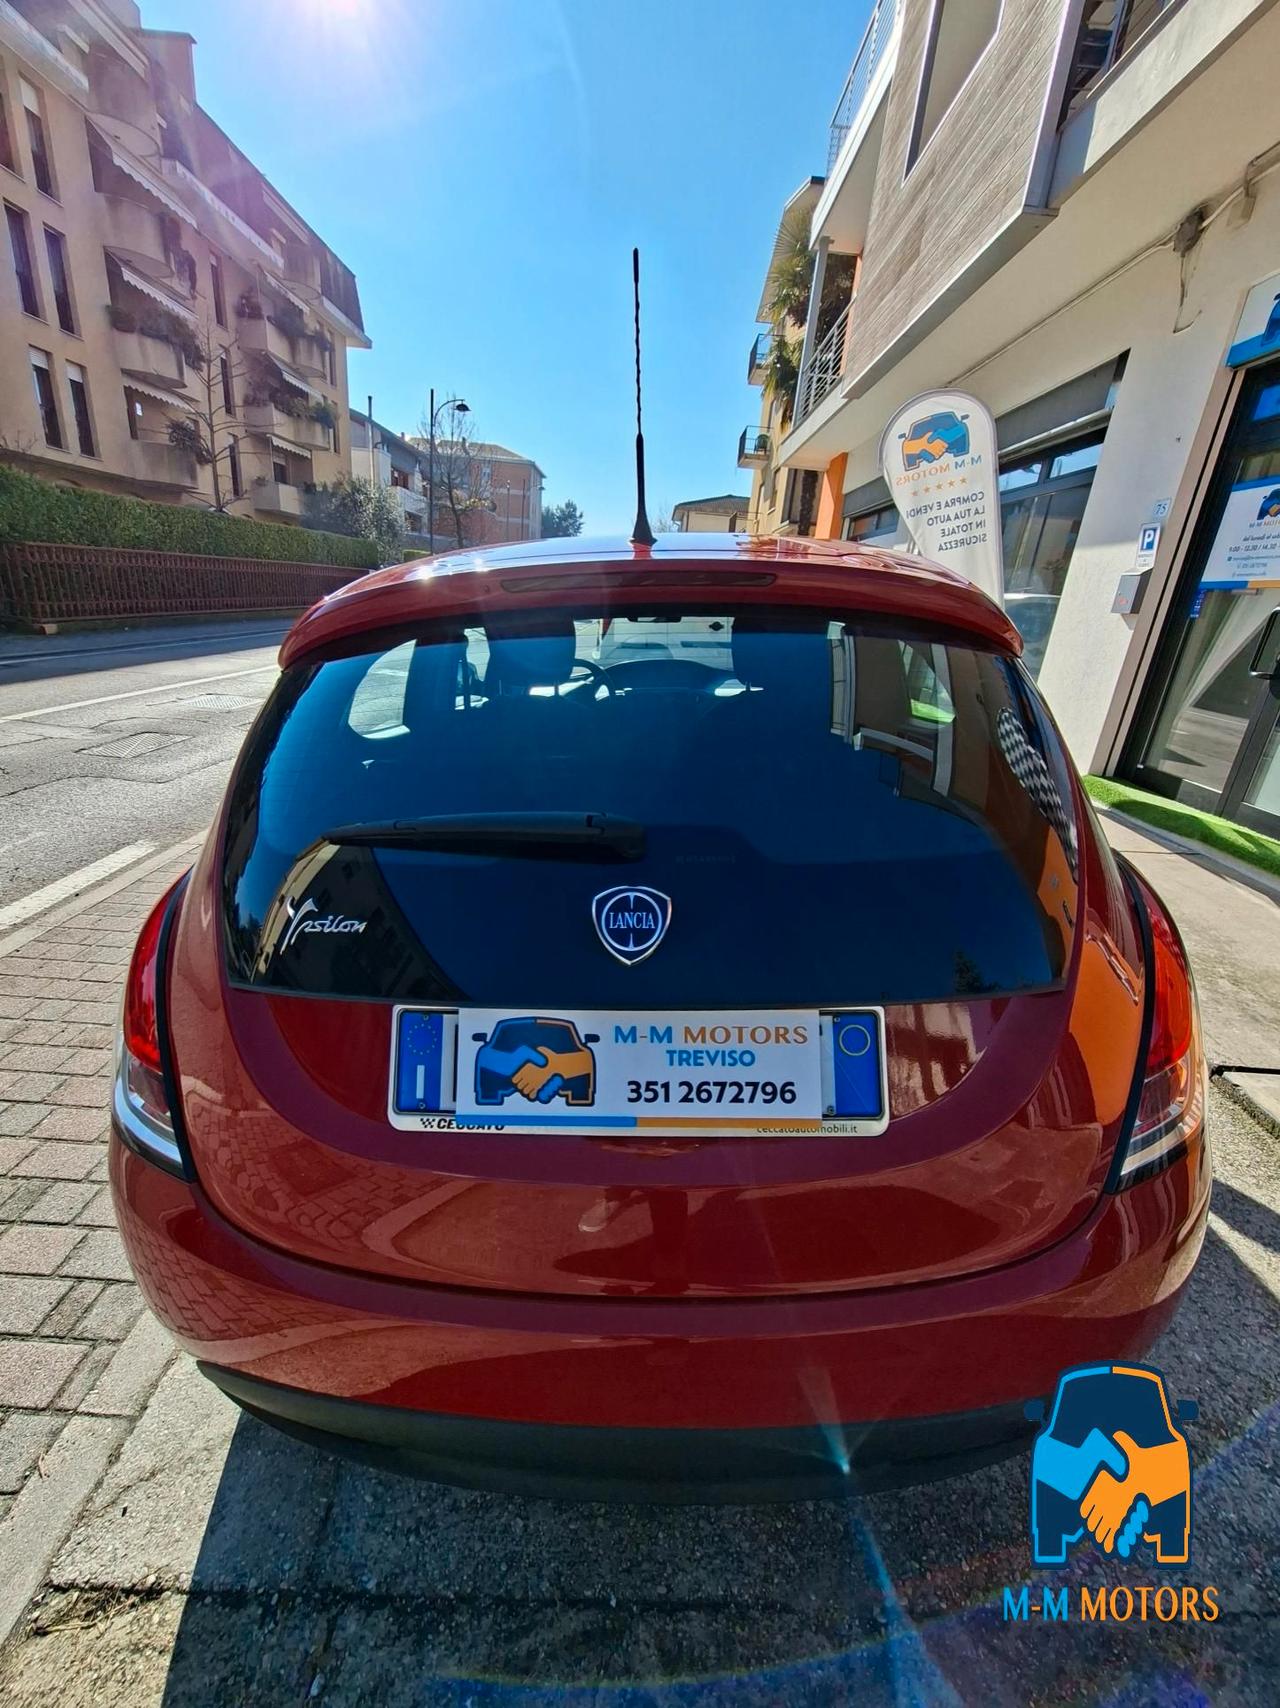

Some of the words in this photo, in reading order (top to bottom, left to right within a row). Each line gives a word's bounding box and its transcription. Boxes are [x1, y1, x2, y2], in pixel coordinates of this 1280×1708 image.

[1155, 503, 1167, 515] 75
[1143, 529, 1155, 550] P
[280, 896, 368, 955] Ypsilon
[608, 911, 655, 929] LANCIA
[614, 1025, 673, 1044] M-M
[683, 1025, 808, 1045] MOTORS
[666, 1049, 756, 1067] TREVISO
[627, 1080, 670, 1104] 351
[678, 1080, 797, 1105] 2672796
